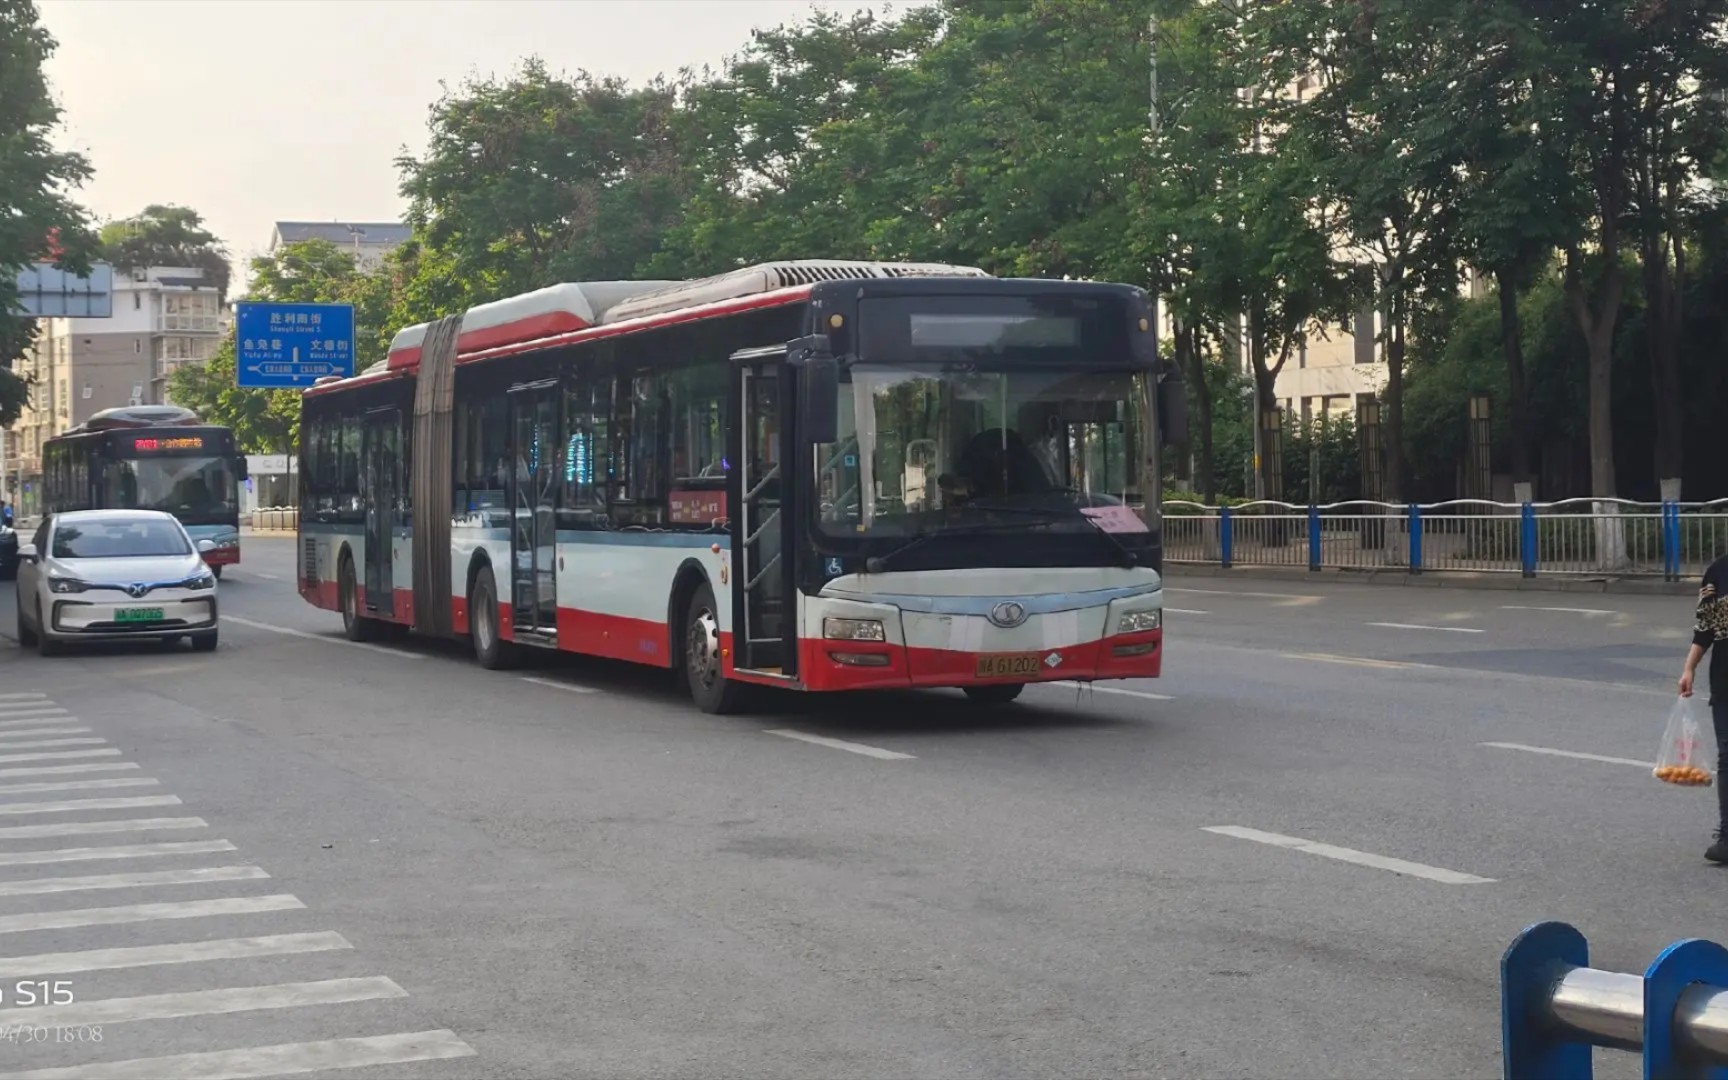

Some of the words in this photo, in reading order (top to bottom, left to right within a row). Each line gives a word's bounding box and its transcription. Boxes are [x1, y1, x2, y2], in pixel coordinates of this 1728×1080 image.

[270, 312, 322, 325] 胜利南街
[296, 325, 315, 333] Street
